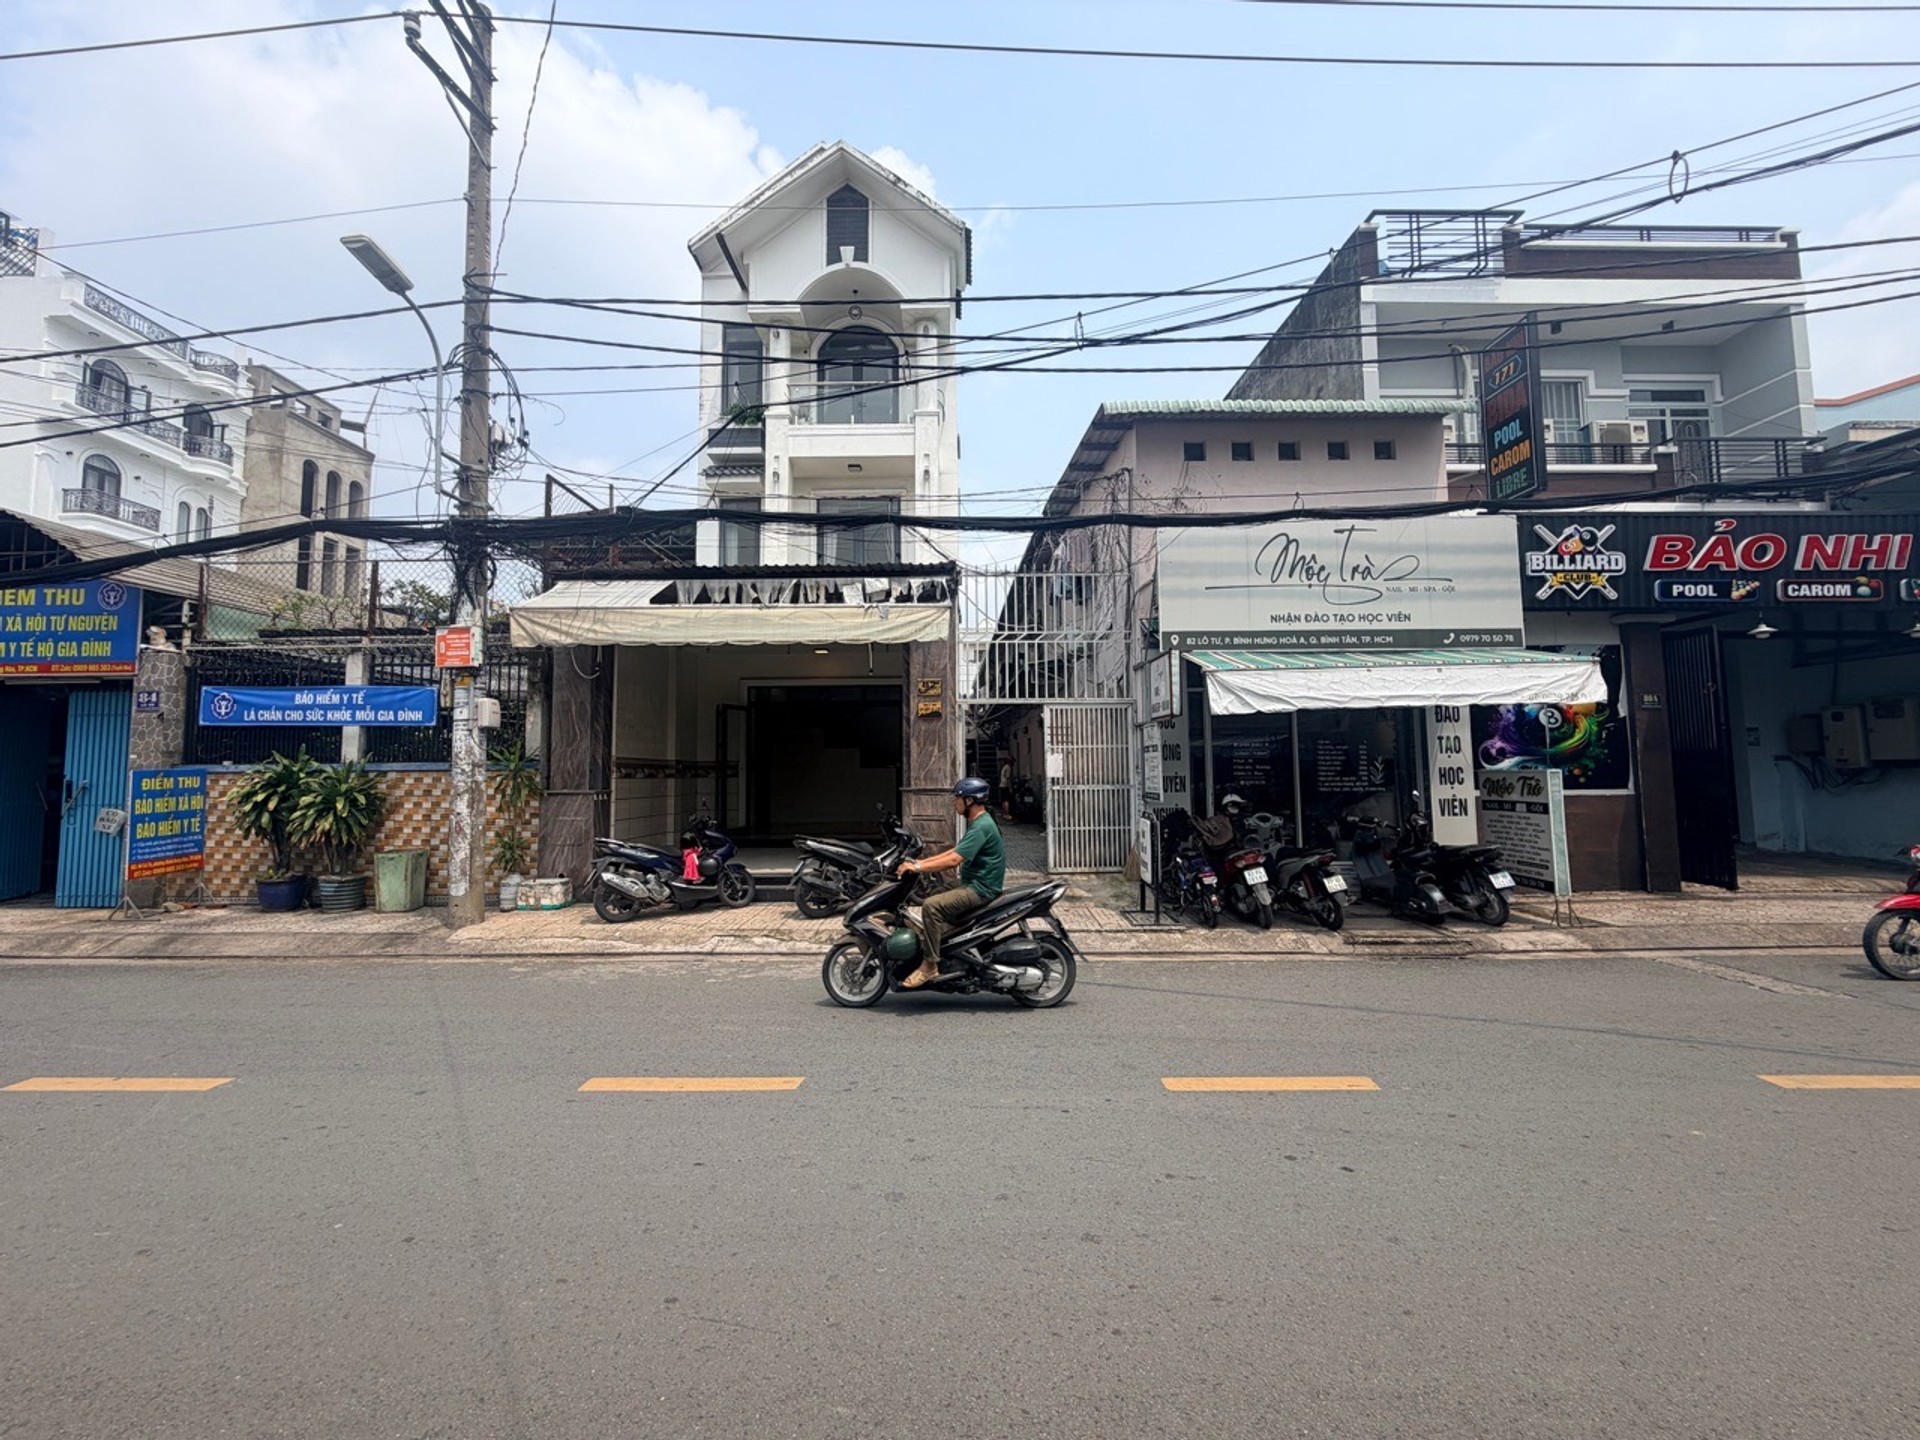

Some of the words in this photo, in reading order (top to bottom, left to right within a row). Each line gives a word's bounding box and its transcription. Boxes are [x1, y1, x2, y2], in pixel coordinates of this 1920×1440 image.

[1493, 419, 1523, 449] POOL
[1490, 439, 1531, 476] CAROM
[1496, 467, 1528, 498] LIBRE
[1643, 519, 1787, 571] BẢO
[1794, 534, 1913, 571] NHI
[1531, 555, 1623, 570] BILLIARD
[1563, 573, 1591, 581] CLUB
[44, 588, 85, 606] THU
[1672, 584, 1718, 597] POOL
[1787, 584, 1851, 597] CAROM
[6, 613, 22, 631] XÃ
[26, 612, 46, 635] HỘI
[50, 614, 67, 635] TỰ
[68, 612, 118, 634] NGUYỆN
[1271, 612, 1300, 625] NHẬN
[1305, 611, 1329, 623] ĐÀO
[1333, 613, 1355, 625] TẠO
[1359, 613, 1383, 625] HỌC
[1386, 611, 1411, 623] VIÊN
[9, 642, 16, 657] Y
[20, 637, 35, 657] TẾ
[38, 638, 53, 661] HỘ
[57, 641, 78, 657] GIA
[81, 638, 112, 657] ĐÌNH
[1374, 635, 1393, 644] HCM
[1460, 634, 1479, 643] 0979
[1481, 634, 1491, 643] 70
[1493, 634, 1503, 643] 50
[295, 690, 313, 705] BẢO
[316, 689, 340, 705] HIỂM
[342, 693, 349, 705] Y
[352, 689, 367, 705] TẾ
[244, 708, 256, 721] LÁ
[257, 705, 282, 721] CHẮN
[285, 710, 303, 721] CHO
[306, 708, 325, 721] SỨC
[327, 707, 352, 721] KHỎE
[378, 710, 394, 721] GIA
[397, 708, 422, 721] ĐÌNH
[1162, 740, 1182, 761] ÓNG
[1437, 735, 1462, 759] TẠO
[141, 773, 174, 790] ĐIỂM
[178, 776, 200, 789] THU
[1162, 771, 1186, 793] UYÊN
[1439, 767, 1464, 790] HỌC
[135, 794, 153, 815] BẢO
[155, 791, 176, 813] HIỂM
[178, 793, 189, 811] XÃ
[191, 792, 204, 813] HỘI
[1439, 794, 1468, 817] VIÊN
[136, 817, 156, 839] BẢO
[158, 814, 181, 837] HIỂM
[183, 819, 189, 834] Y
[191, 812, 202, 832] TẾ
